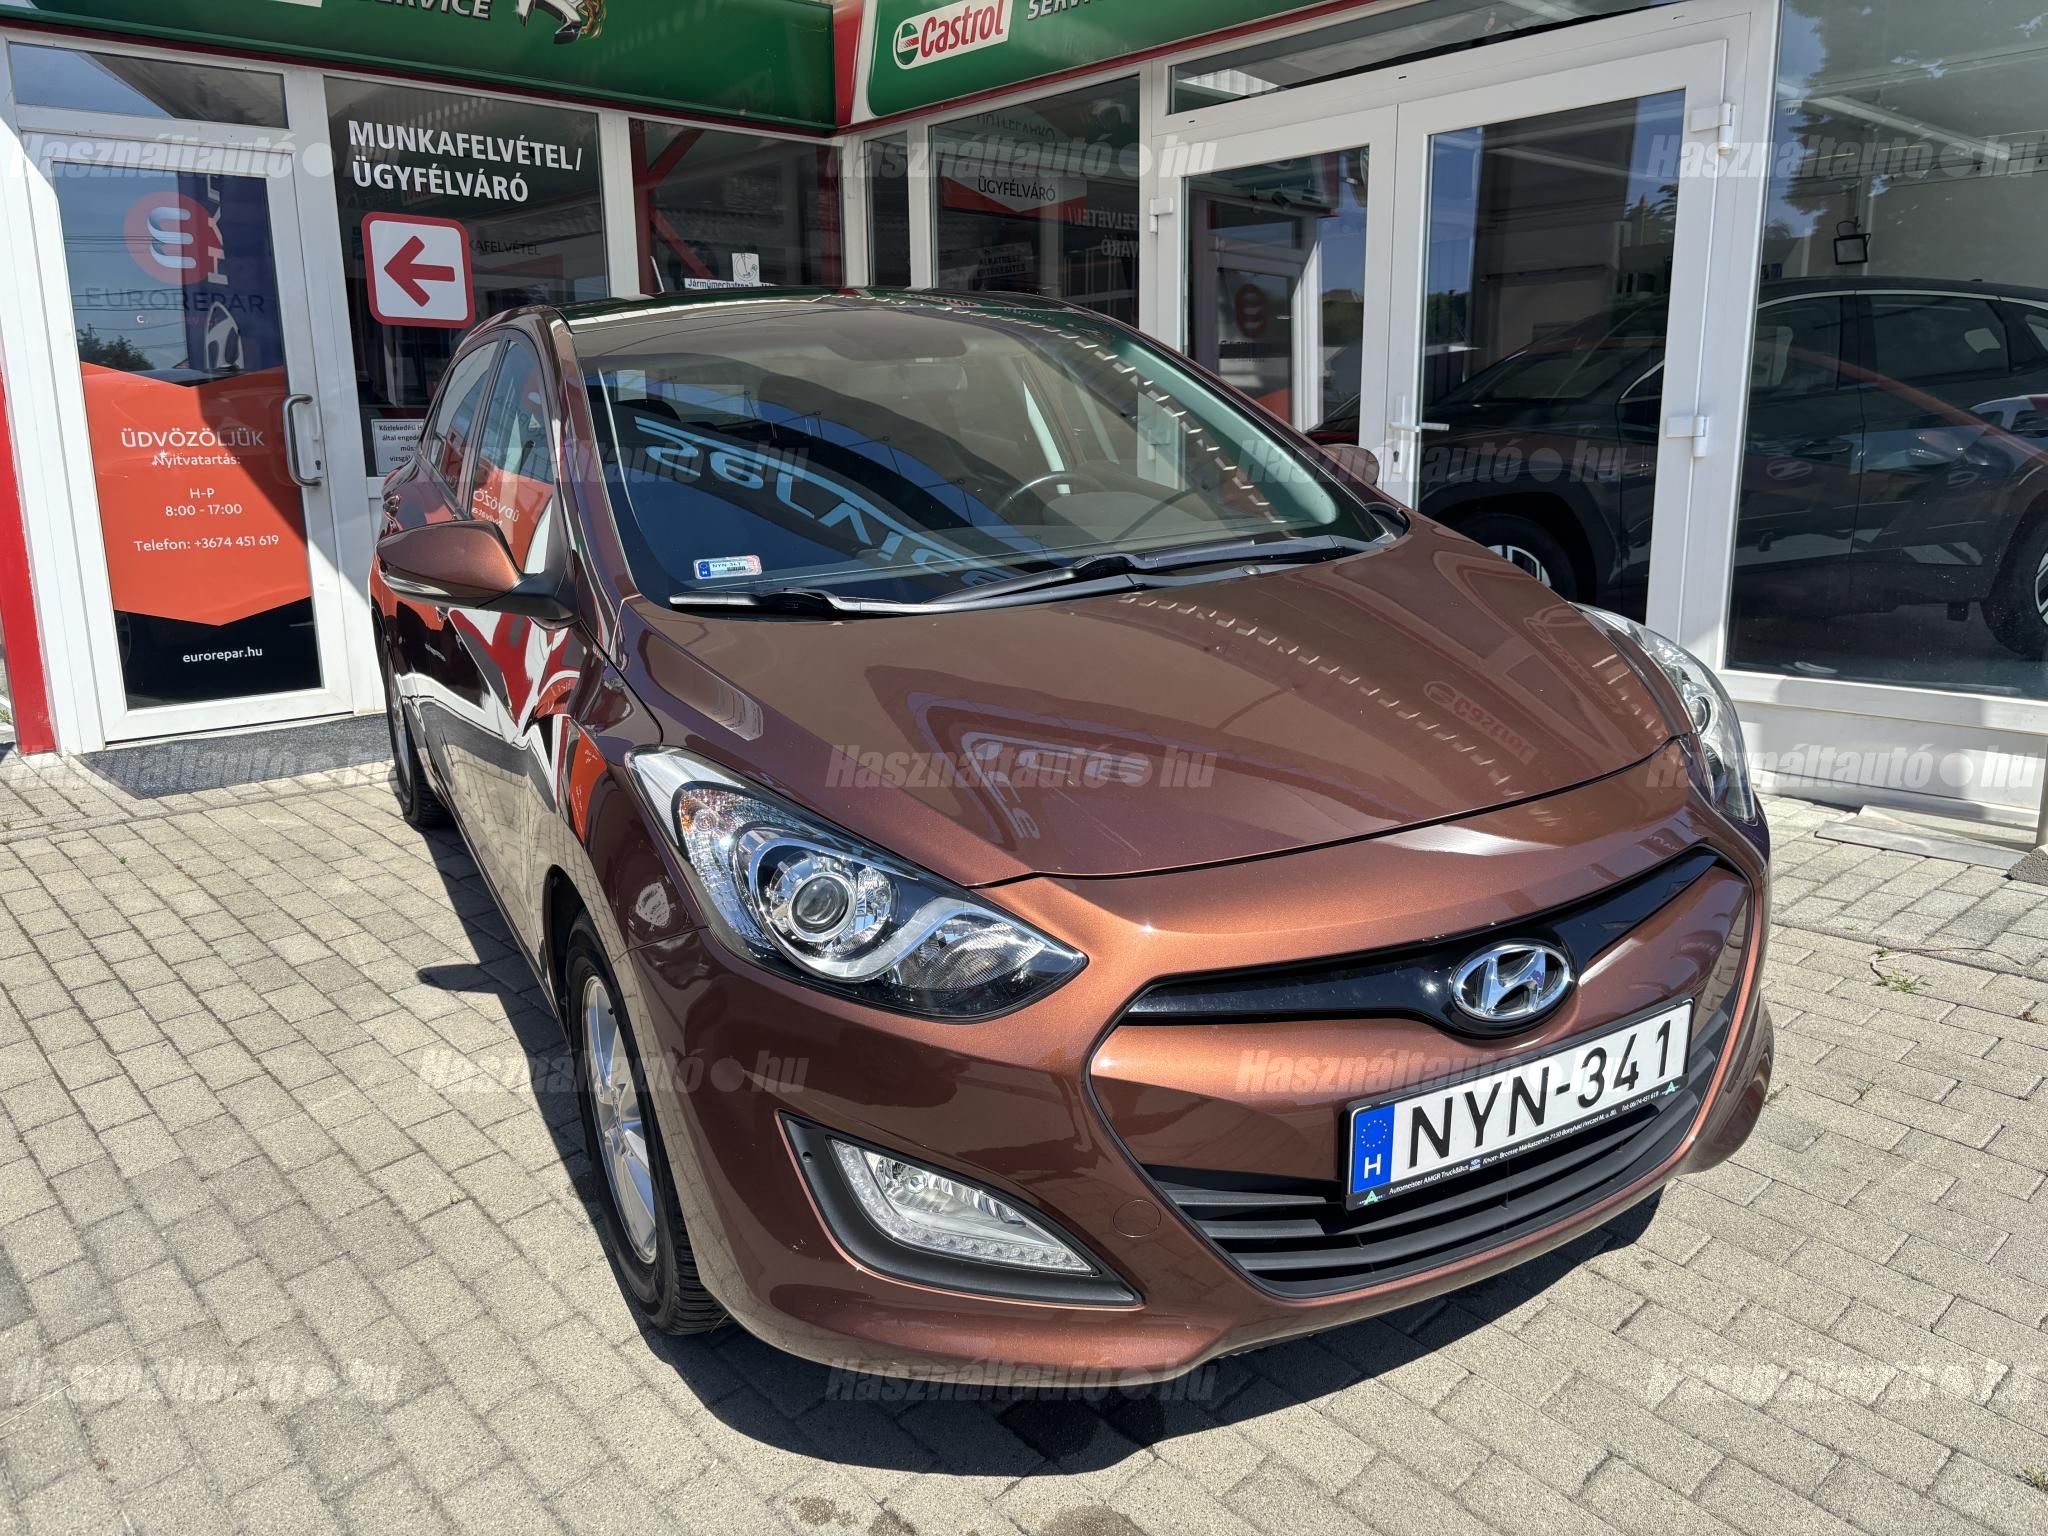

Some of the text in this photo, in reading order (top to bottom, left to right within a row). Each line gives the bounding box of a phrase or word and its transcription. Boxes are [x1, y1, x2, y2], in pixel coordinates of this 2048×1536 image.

[921, 0, 1003, 58] Castrol
[348, 118, 582, 174] MUNKAFELVÉTEL/
[352, 159, 529, 203] ÜGYFÉLVÁRÓ
[978, 176, 1056, 201] ÜGYFÉLVÁRÓ
[120, 426, 266, 450] ÜDVÖZÖLJÜK
[151, 451, 241, 469] Nyitvatartás:
[189, 487, 215, 500] H-P
[165, 504, 195, 517] 8:00
[209, 502, 242, 516] 17:00
[133, 533, 280, 553] Telefon: +3674 451 619
[182, 646, 263, 666] eurorepar.hu
[1408, 1019, 1672, 1169] NYN-341
[1363, 1154, 1381, 1179] H
